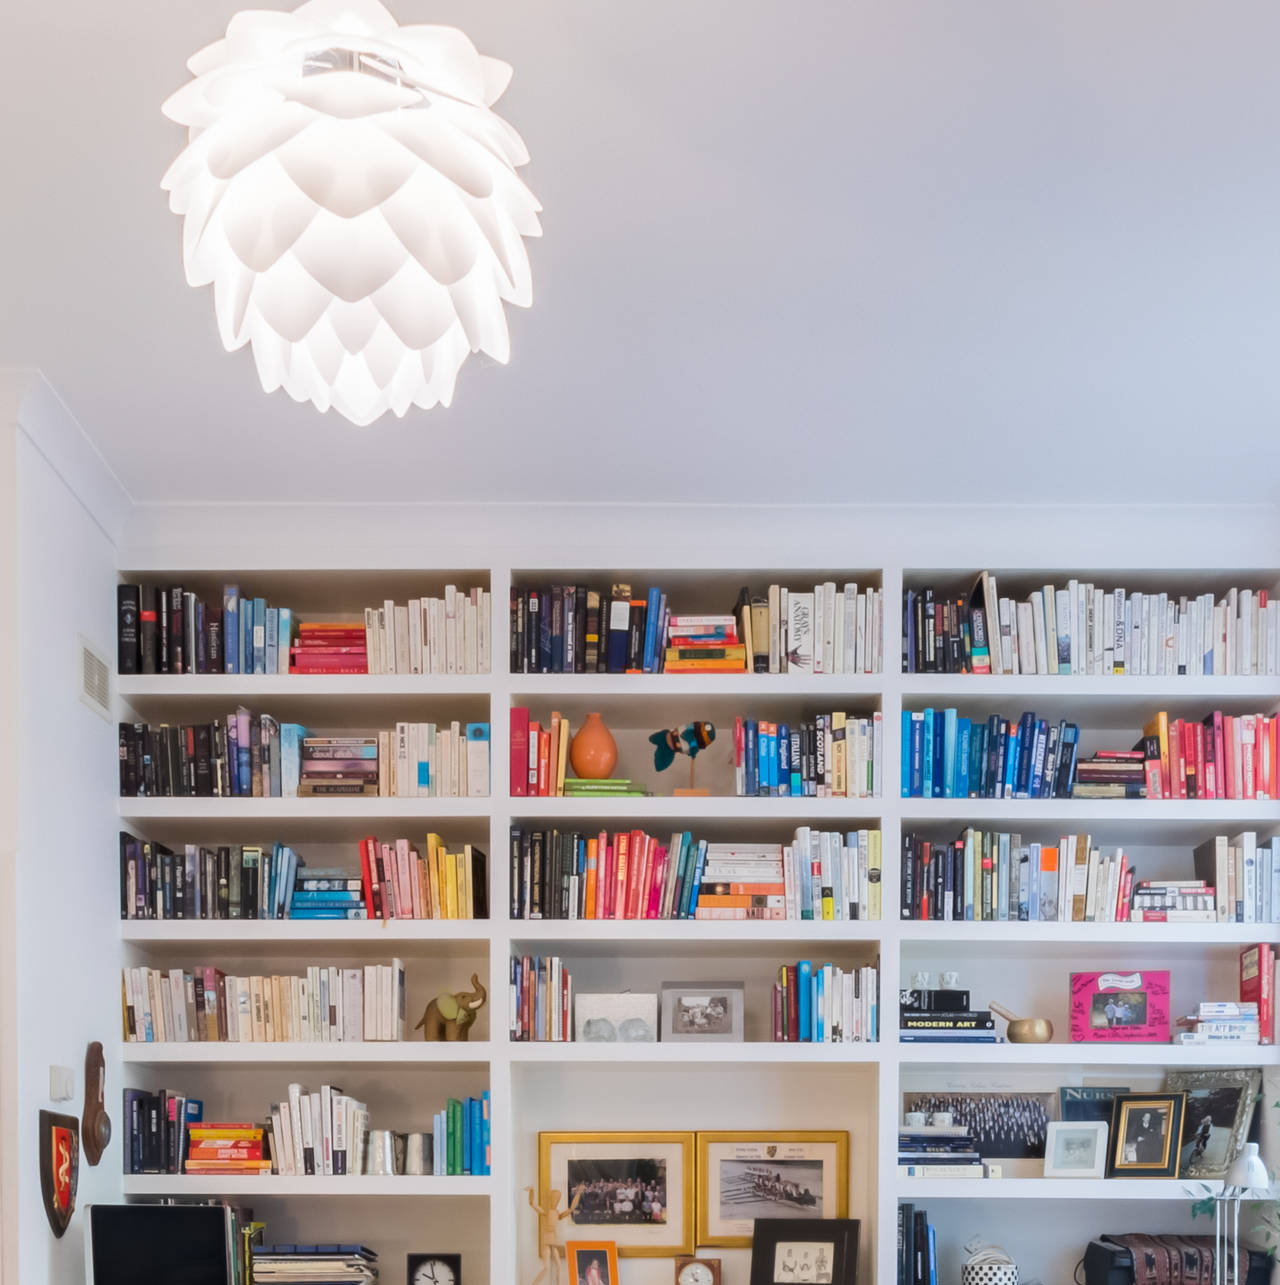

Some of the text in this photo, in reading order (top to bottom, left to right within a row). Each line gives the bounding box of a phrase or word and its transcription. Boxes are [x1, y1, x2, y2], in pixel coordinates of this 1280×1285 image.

[793, 600, 802, 642] ANATOMY
[1115, 628, 1124, 650] DNA
[791, 737, 800, 766] ITALIAN
[816, 730, 824, 774] SCOTLAND
[907, 1020, 954, 1028] MODERN
